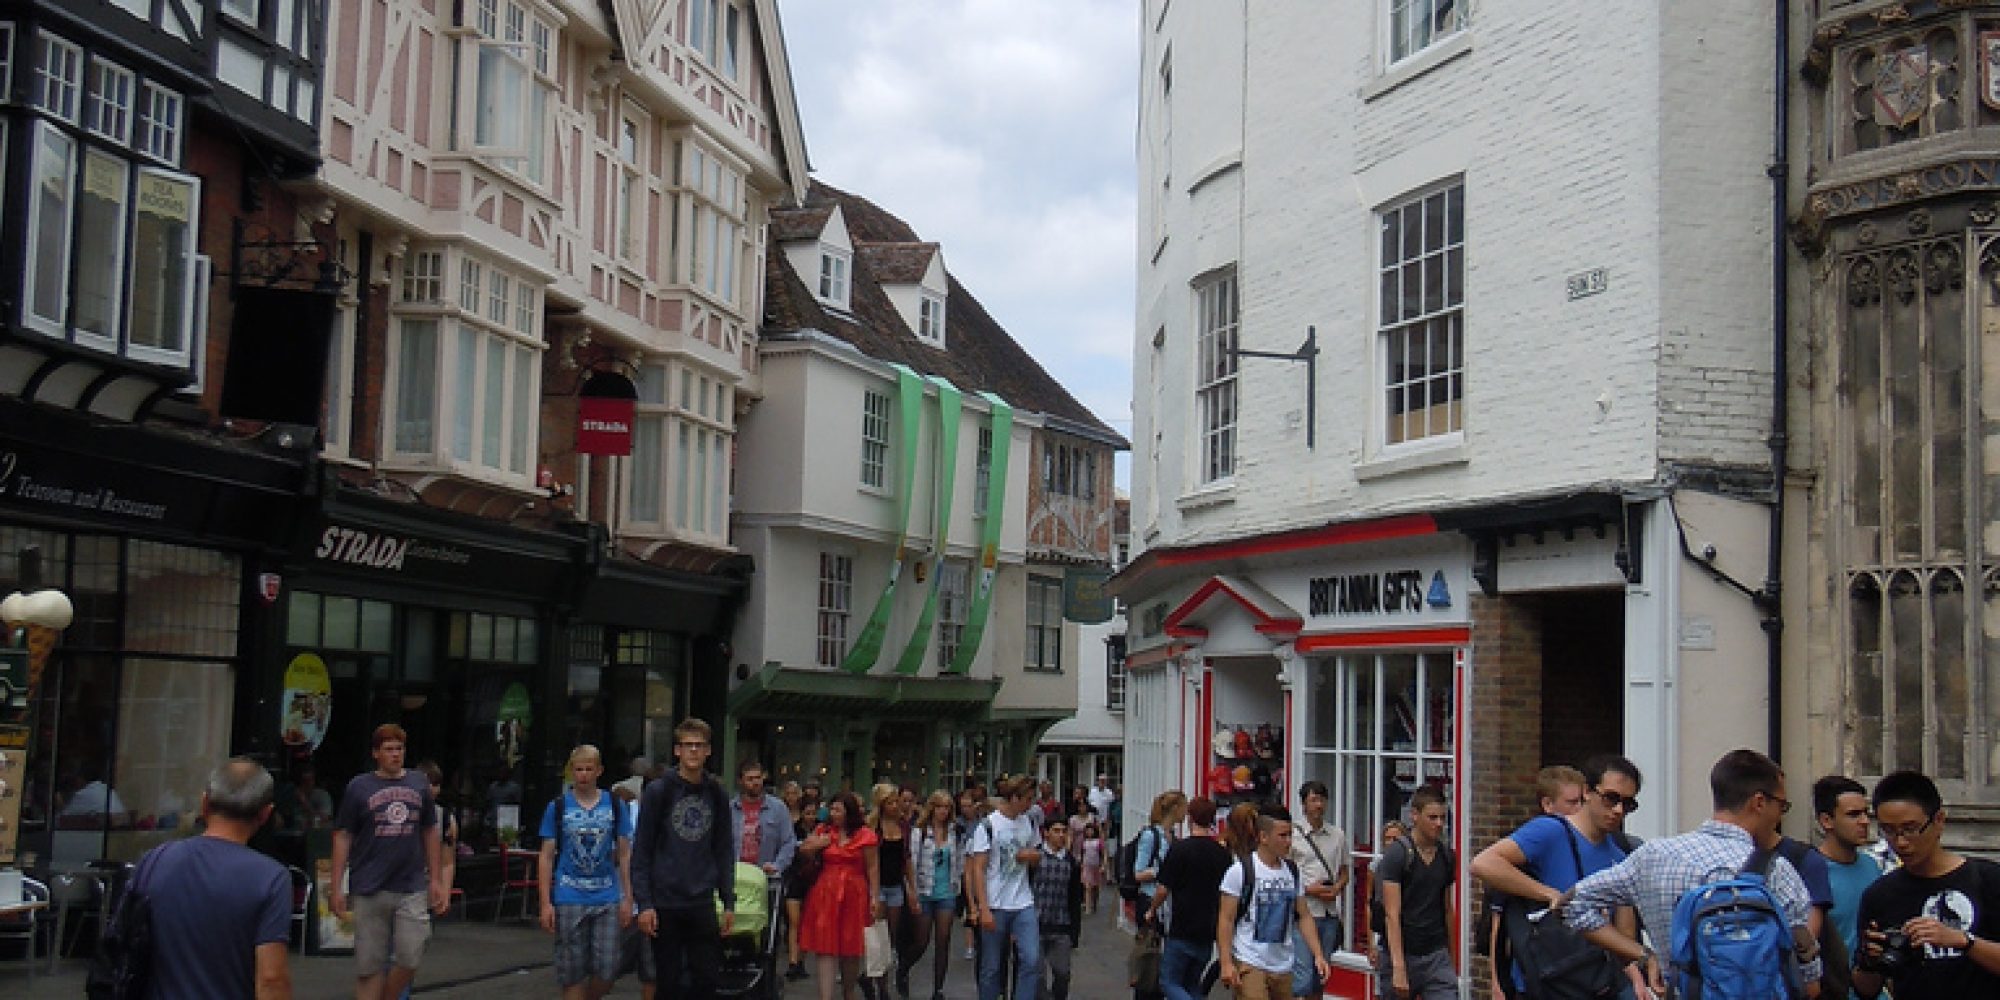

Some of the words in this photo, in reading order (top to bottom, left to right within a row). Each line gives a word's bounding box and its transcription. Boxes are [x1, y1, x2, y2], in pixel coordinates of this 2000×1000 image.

[582, 419, 628, 432] STRADA
[17, 476, 73, 503] Tearoom
[315, 525, 407, 571] STRADA
[1309, 573, 1380, 616] BRITANNIA
[1383, 569, 1423, 613] GIFTS
